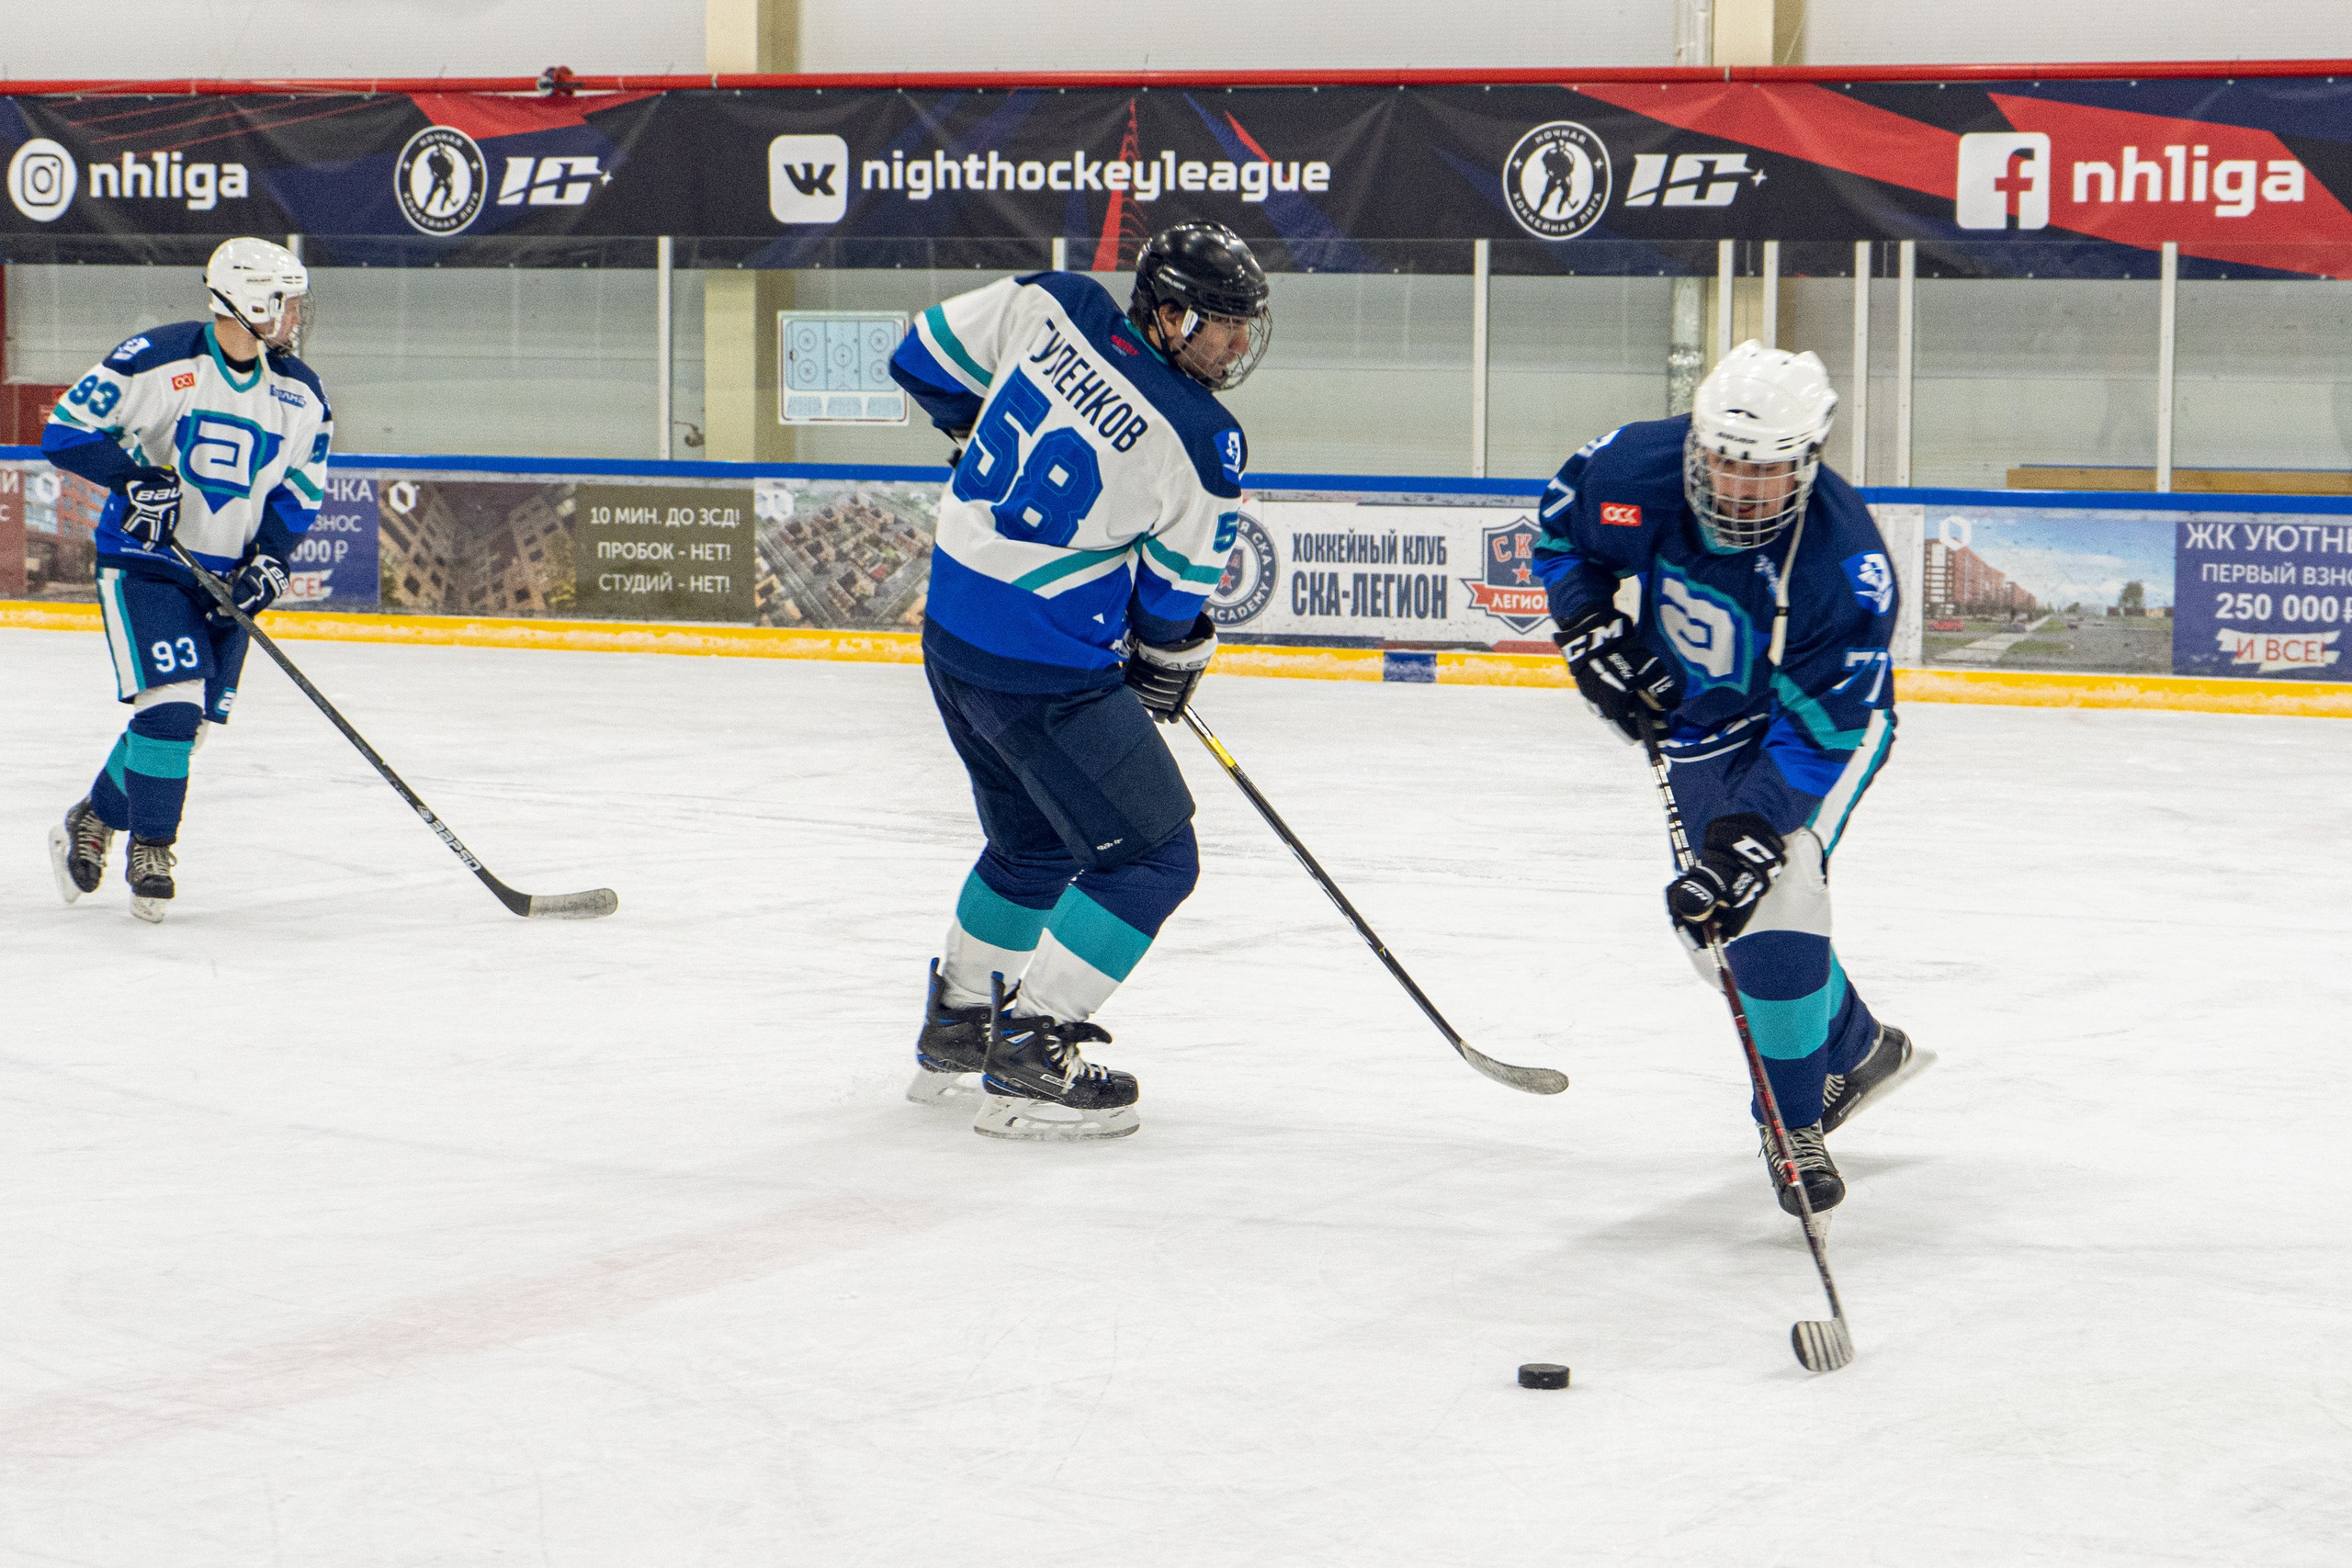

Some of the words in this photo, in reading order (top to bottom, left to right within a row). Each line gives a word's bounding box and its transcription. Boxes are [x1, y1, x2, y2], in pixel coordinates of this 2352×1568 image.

[1534, 130, 1587, 145] НОЧНАЯ
[90, 152, 249, 210] nhliga
[861, 151, 1332, 201] nighthockeyleague
[2072, 145, 2305, 218] nhliga
[1511, 191, 1577, 233] ХОККЕЙНАЯ
[1579, 191, 1603, 224] ЛИГА
[952, 364, 1103, 548] 58
[590, 507, 611, 525] 10
[615, 507, 662, 525] МИН.
[665, 507, 695, 528] ДО
[698, 507, 741, 529] ЗСД!
[2185, 523, 2236, 550] ЖК
[597, 541, 674, 560] ПРОБОК
[690, 543, 731, 561] НЕТ!
[1292, 526, 1398, 565] ХОККЕЙНЫЙ
[1402, 535, 1447, 566] КЛУБ
[598, 570, 673, 594] СТУДИЙ
[690, 575, 730, 593] НЕТ!
[2201, 561, 2296, 585] ПЕРВЫЙ
[1206, 581, 1270, 622] ACADEMY
[1292, 570, 1448, 620] СКА-ЛЕГИОН
[2215, 592, 2273, 620] 250
[2281, 593, 2339, 623] 000
[152, 636, 199, 673] 93
[2235, 637, 2255, 661] И
[2265, 638, 2326, 663] ВСЕ!
